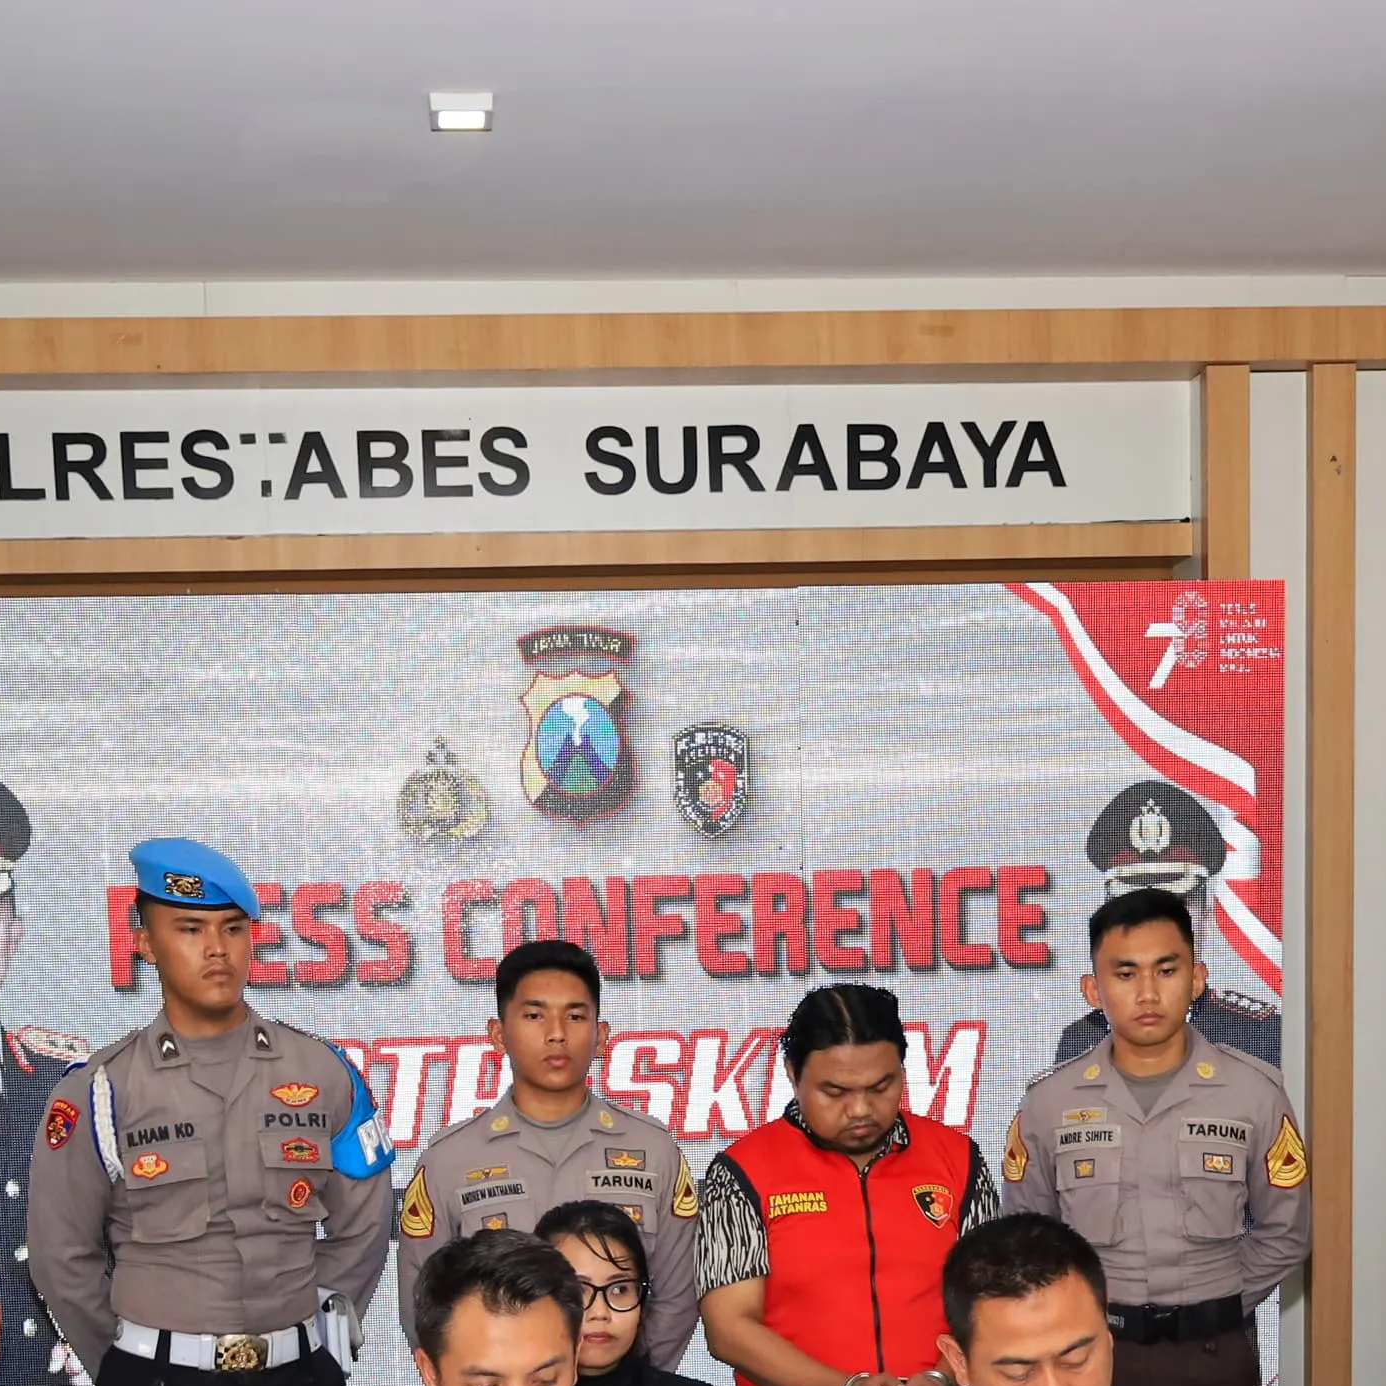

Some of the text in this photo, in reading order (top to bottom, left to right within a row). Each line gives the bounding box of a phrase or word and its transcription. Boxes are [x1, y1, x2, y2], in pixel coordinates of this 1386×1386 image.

[584, 420, 1067, 495] SURABAYA
[442, 865, 1051, 982] CONFERENCE
[264, 1112, 327, 1128] POLRI
[127, 1126, 170, 1147] ILHAM
[1059, 1130, 1114, 1146] ANDRE SIHITE
[1187, 1124, 1246, 1142] TARUNA
[592, 1175, 653, 1191] TARUNA
[769, 1192, 824, 1207] TAHANAN
[769, 1201, 828, 1218] JATANRAS
